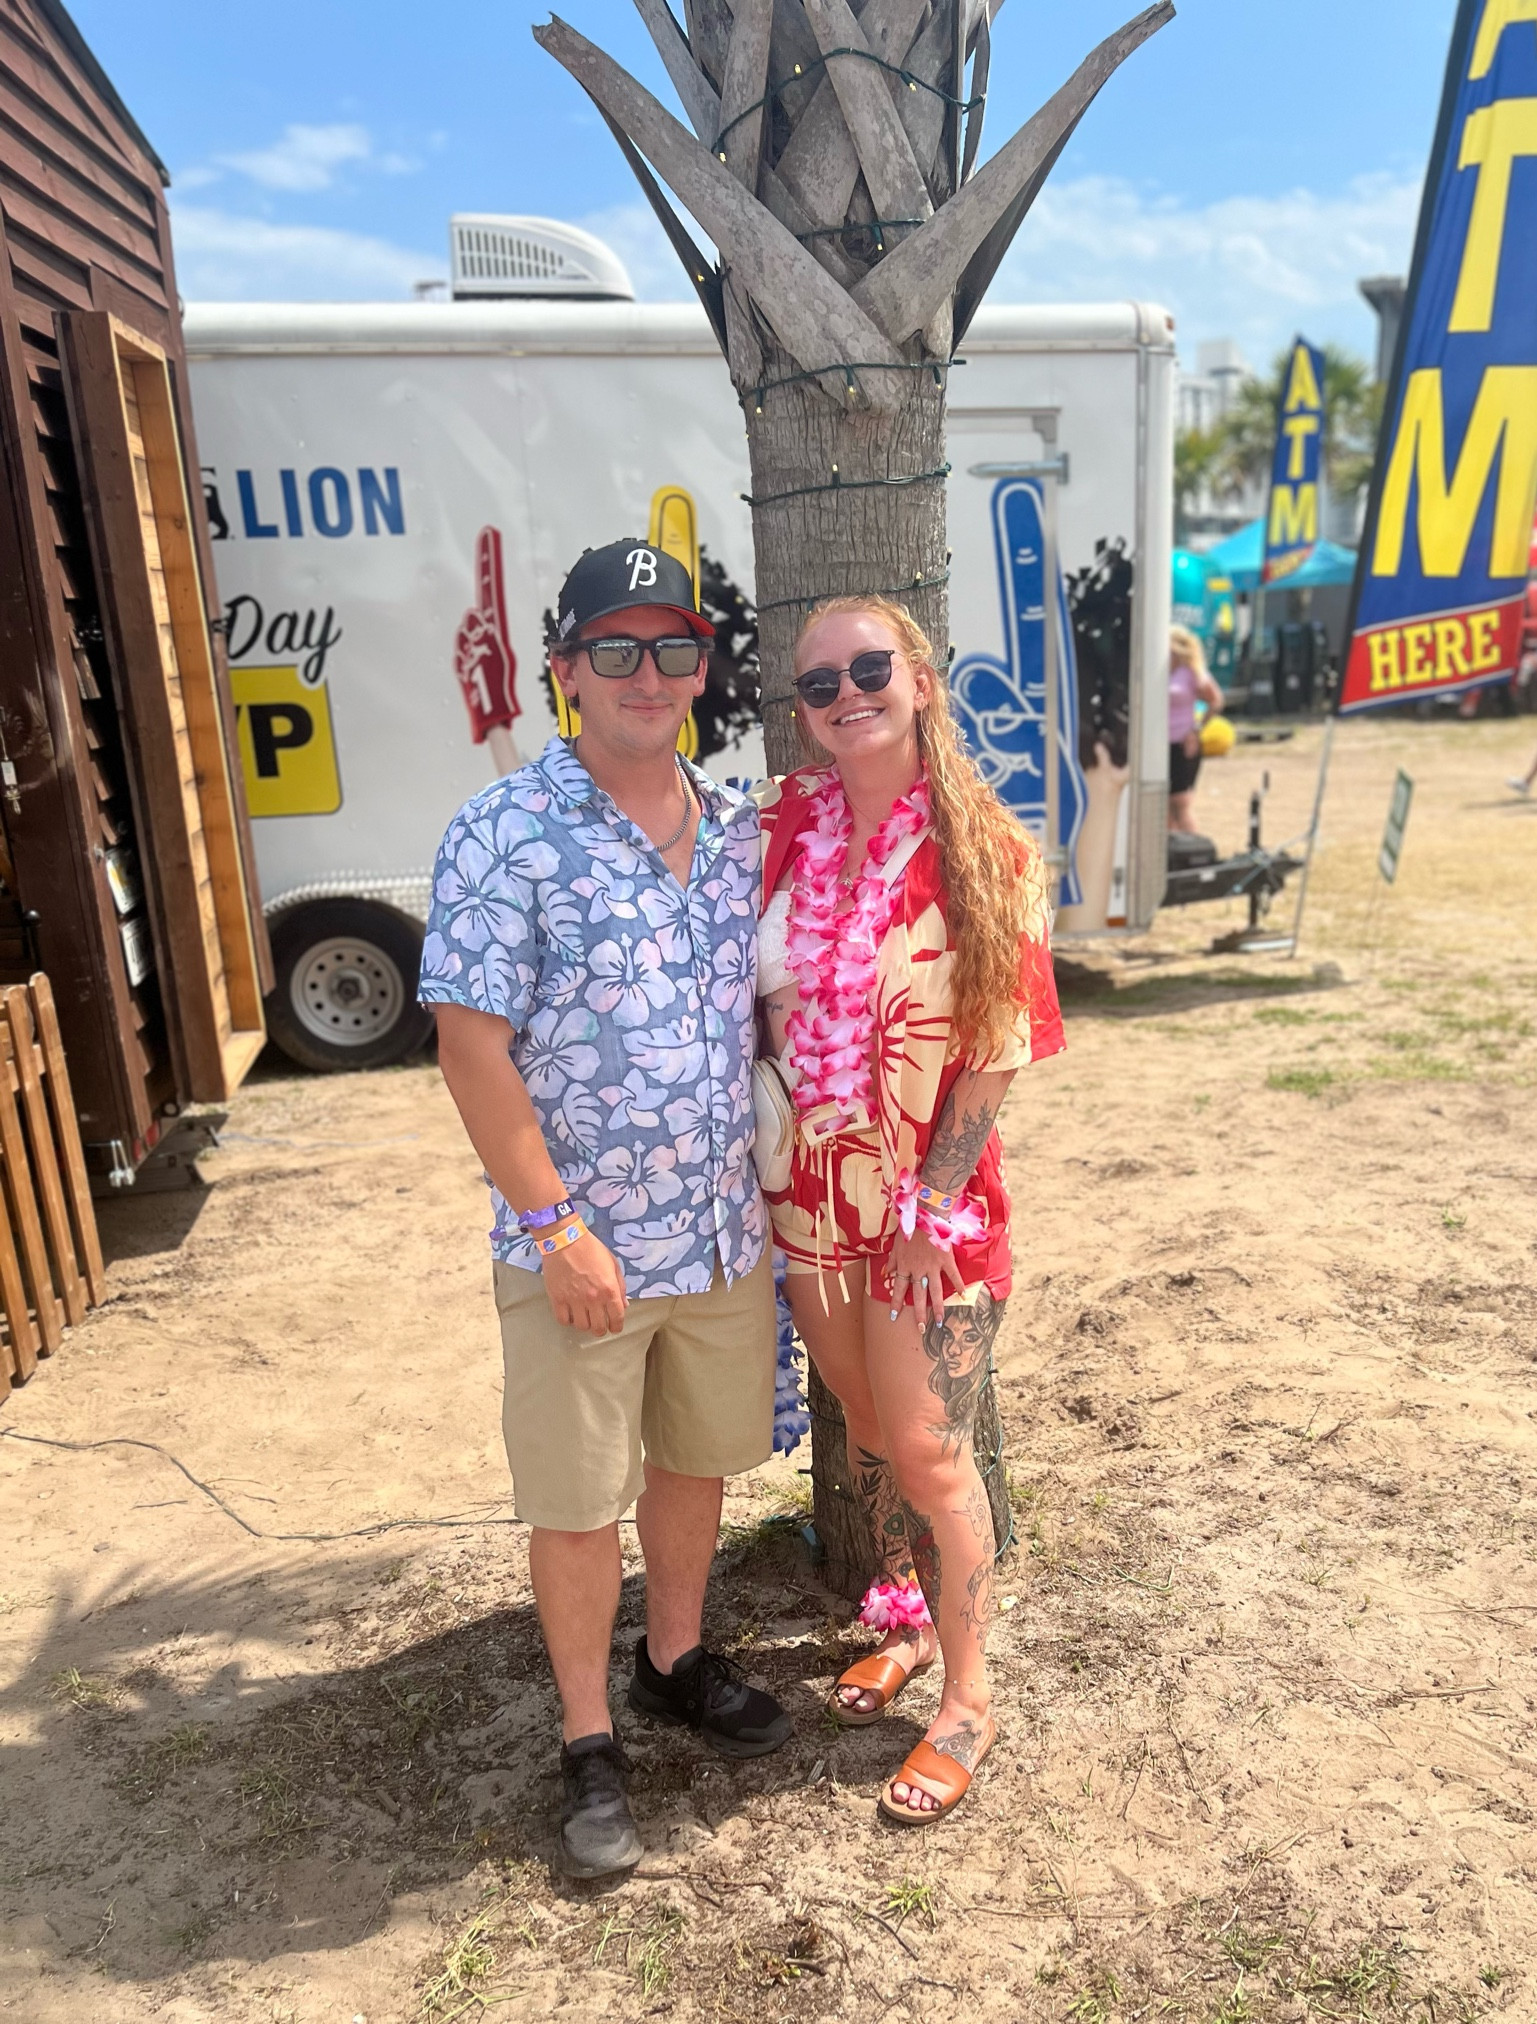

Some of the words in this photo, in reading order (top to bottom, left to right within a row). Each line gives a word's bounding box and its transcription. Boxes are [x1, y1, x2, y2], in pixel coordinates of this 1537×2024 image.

[1268, 345, 1321, 546] ATM
[236, 467, 405, 538] LION
[625, 548, 657, 591] B
[225, 594, 342, 683] Day
[1367, 609, 1500, 690] HERE
[557, 1202, 573, 1216] GA
